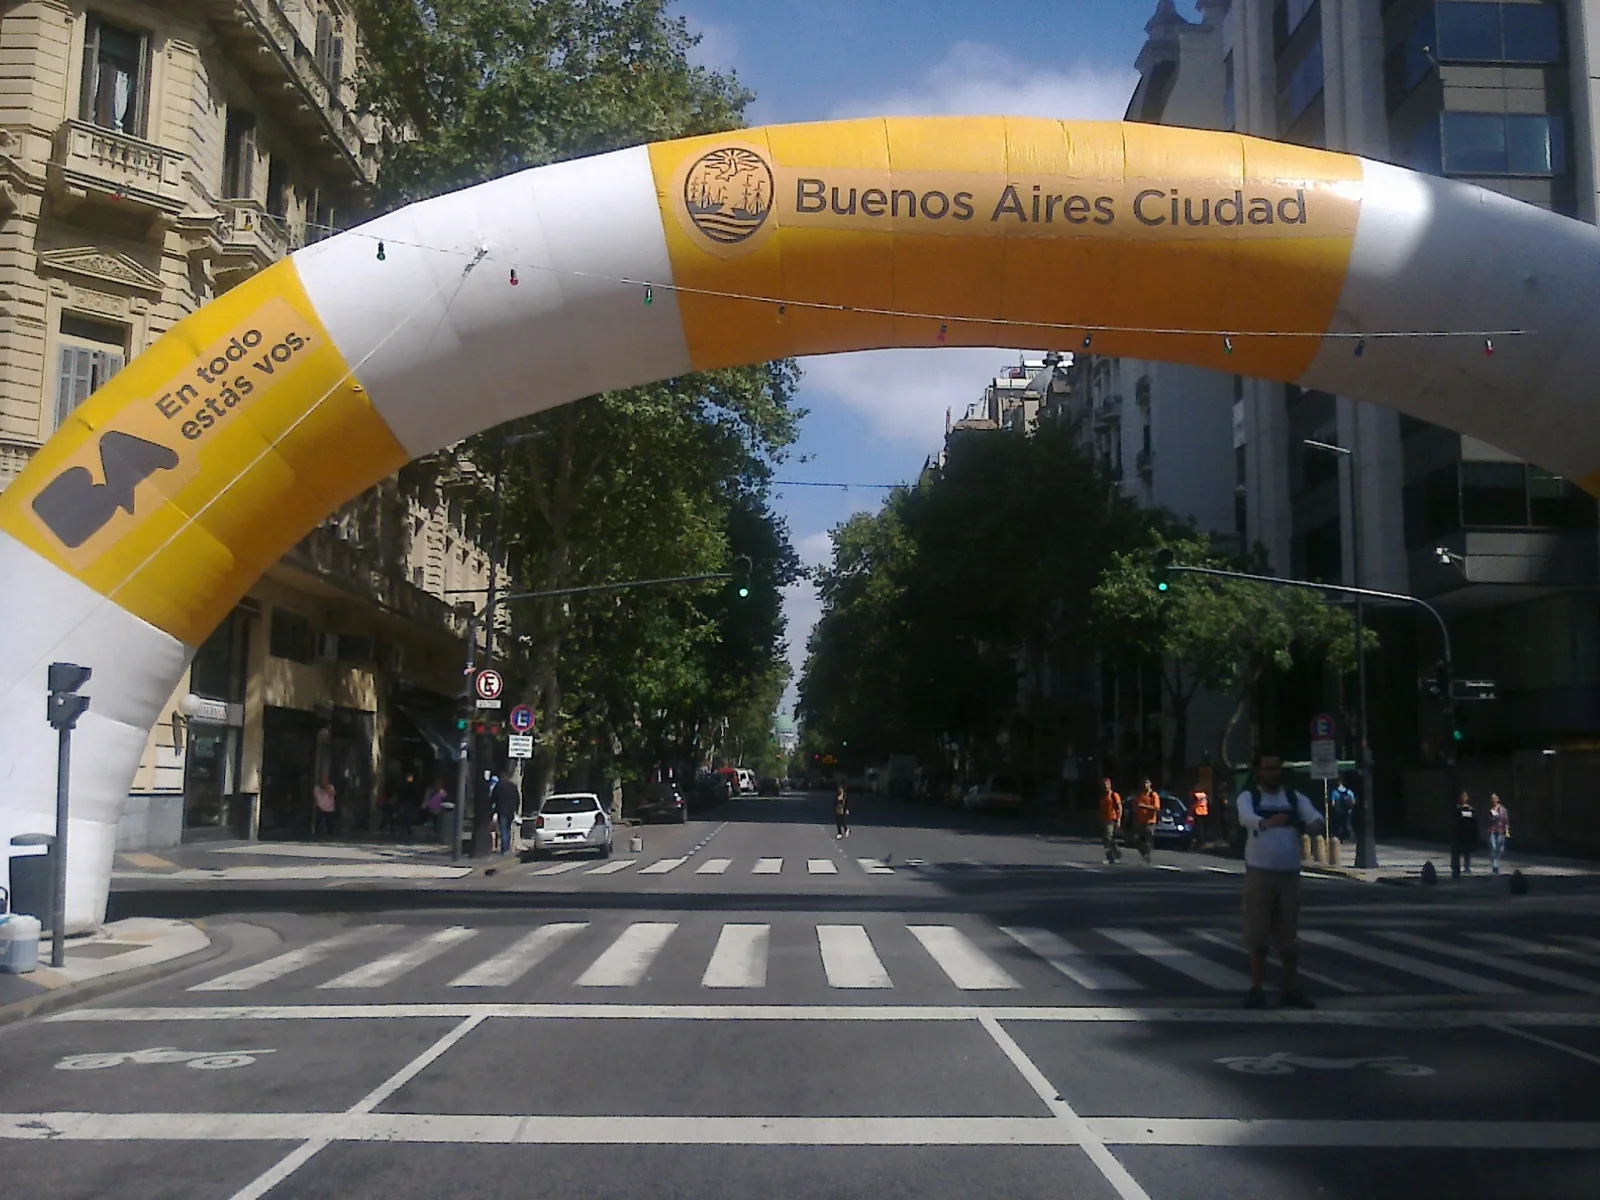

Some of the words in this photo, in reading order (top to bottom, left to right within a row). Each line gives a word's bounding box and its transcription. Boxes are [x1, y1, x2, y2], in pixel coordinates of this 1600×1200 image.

[796, 178, 974, 221] Buenos
[992, 184, 1116, 226] Aires
[1132, 189, 1308, 226] Ciudad
[154, 382, 199, 419] En
[197, 328, 263, 382] todo
[181, 375, 255, 440] estás
[252, 330, 311, 375] vos.
[484, 675, 495, 693] E
[517, 709, 528, 727] E
[1316, 719, 1329, 736] E
